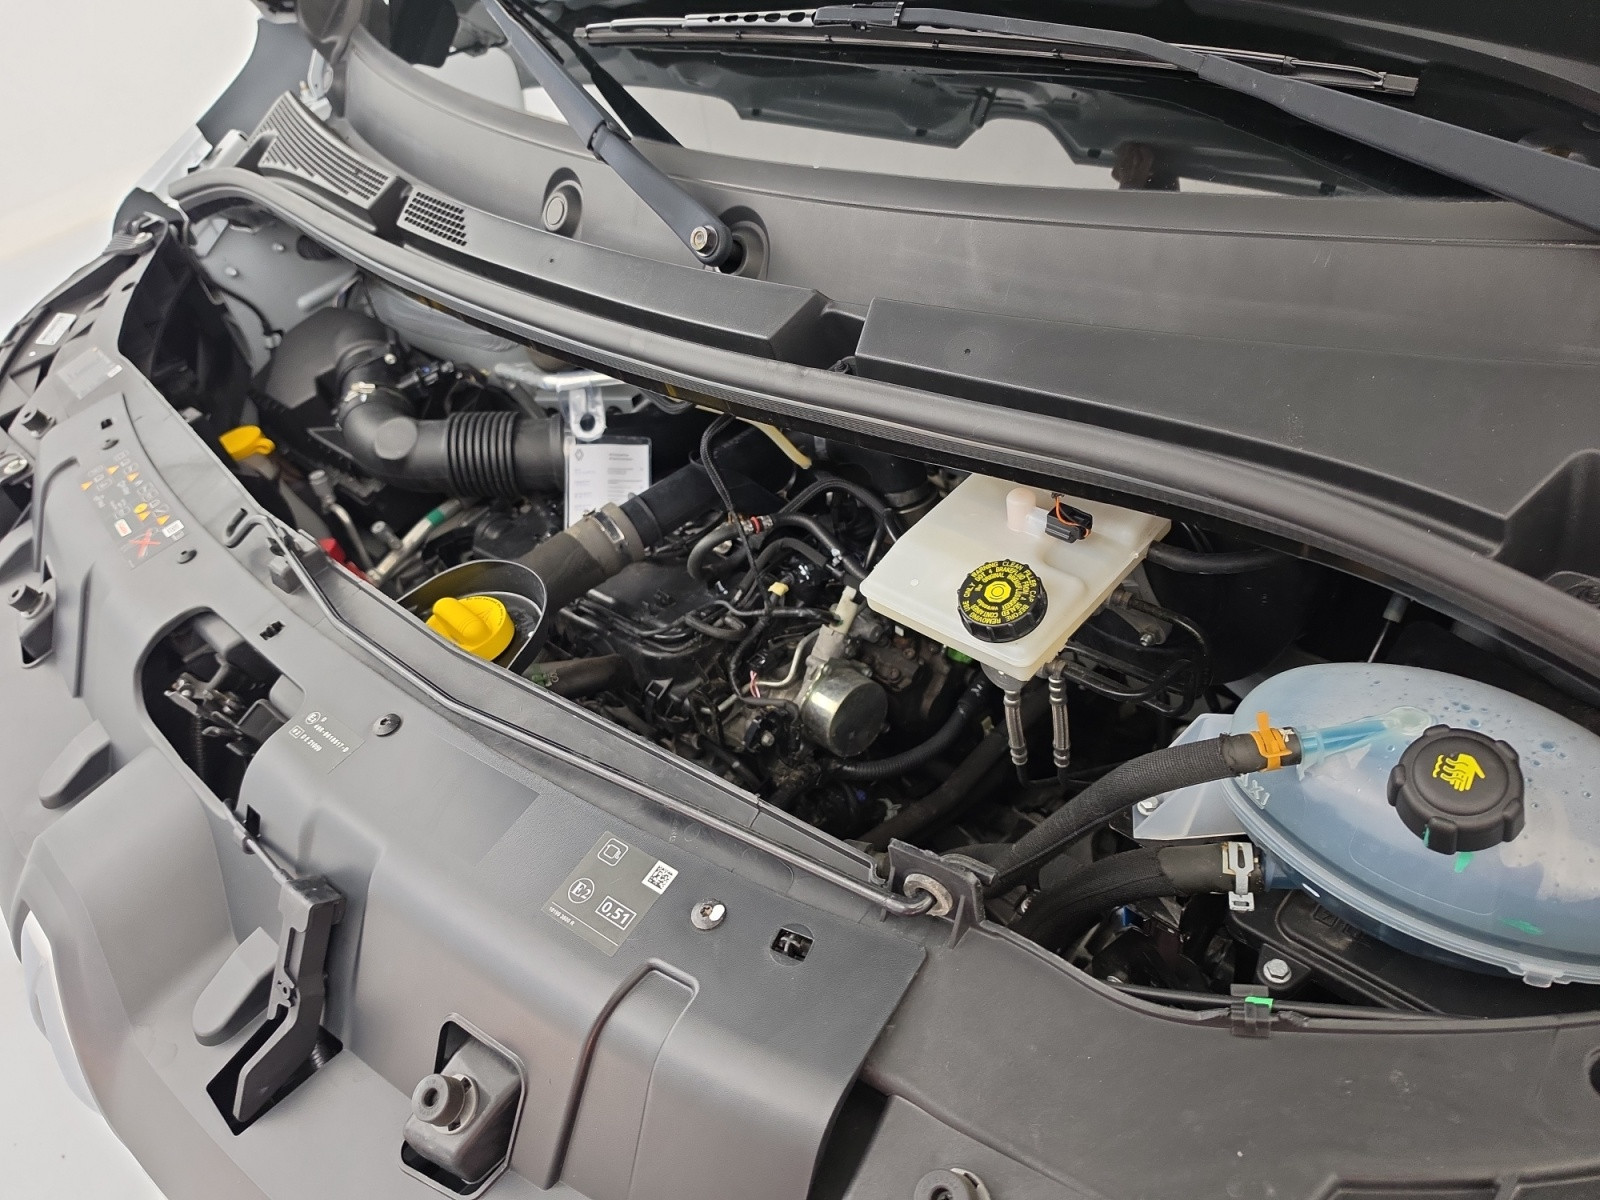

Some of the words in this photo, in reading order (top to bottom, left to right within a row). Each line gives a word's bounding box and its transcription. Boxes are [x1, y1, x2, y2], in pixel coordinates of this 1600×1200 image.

[971, 562, 999, 577] WARNING
[1002, 561, 1024, 571] CLEAN
[974, 571, 986, 582] DOT
[982, 572, 1005, 583] ORIGINAL
[1023, 569, 1037, 587] FILLER
[963, 582, 975, 597] ONLY
[1022, 581, 1030, 595] FROM
[1029, 590, 1037, 603] CAP
[962, 600, 971, 612] USE
[970, 603, 999, 618] CONTAINER
[1001, 602, 1022, 616] SEALED
[1005, 604, 1029, 622] BEFORE
[969, 612, 1002, 624] REMOVING
[570, 881, 591, 899] E2
[601, 902, 630, 924] 0,51
